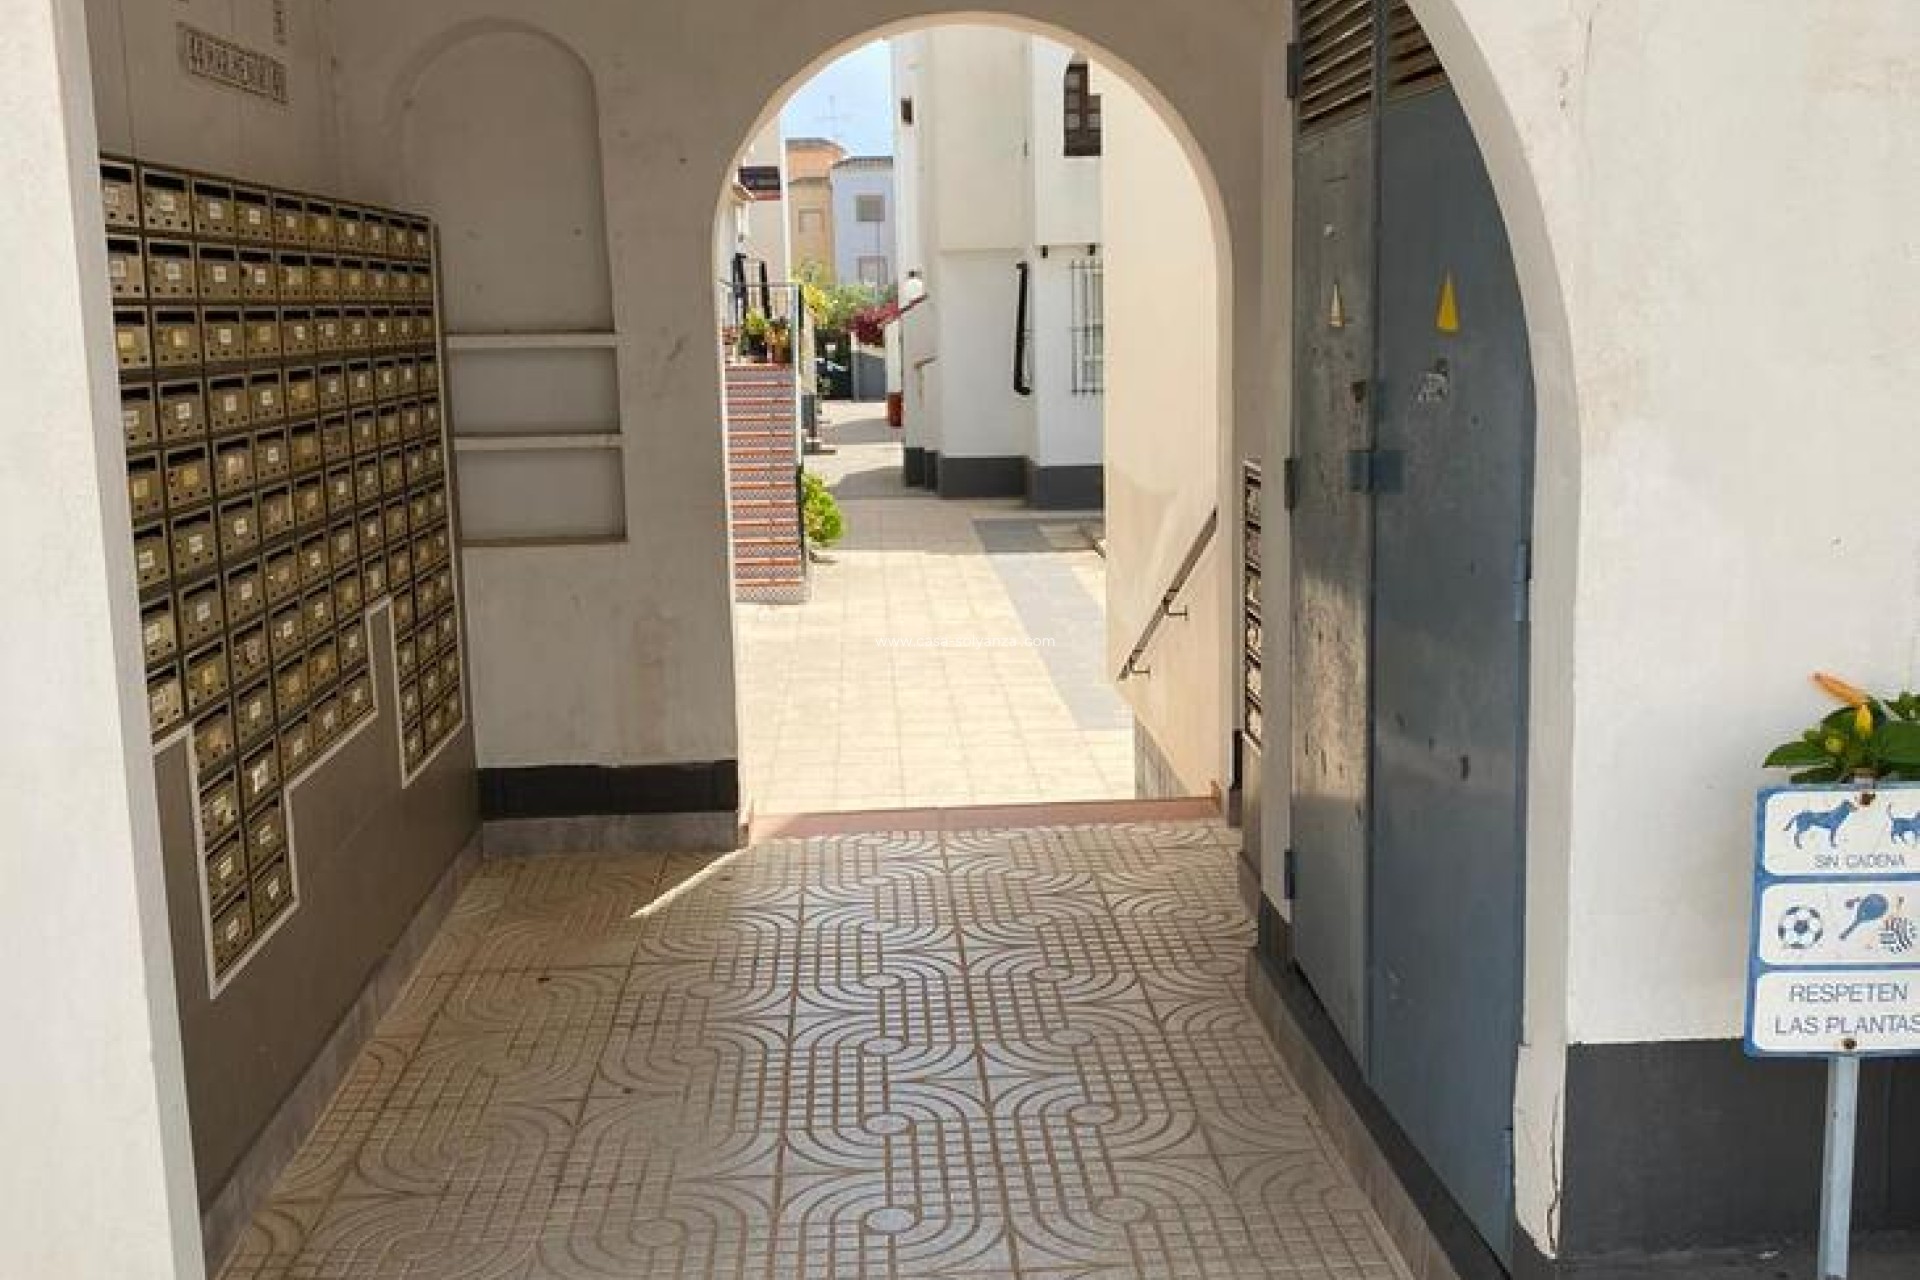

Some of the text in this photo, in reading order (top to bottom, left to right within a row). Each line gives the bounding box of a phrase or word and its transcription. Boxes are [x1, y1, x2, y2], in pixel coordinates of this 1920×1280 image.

[1814, 853, 1905, 868] SIN CADENA
[1789, 982, 1908, 1002] RESPETEN
[1775, 1014, 1920, 1034] LAS PLANTAS
